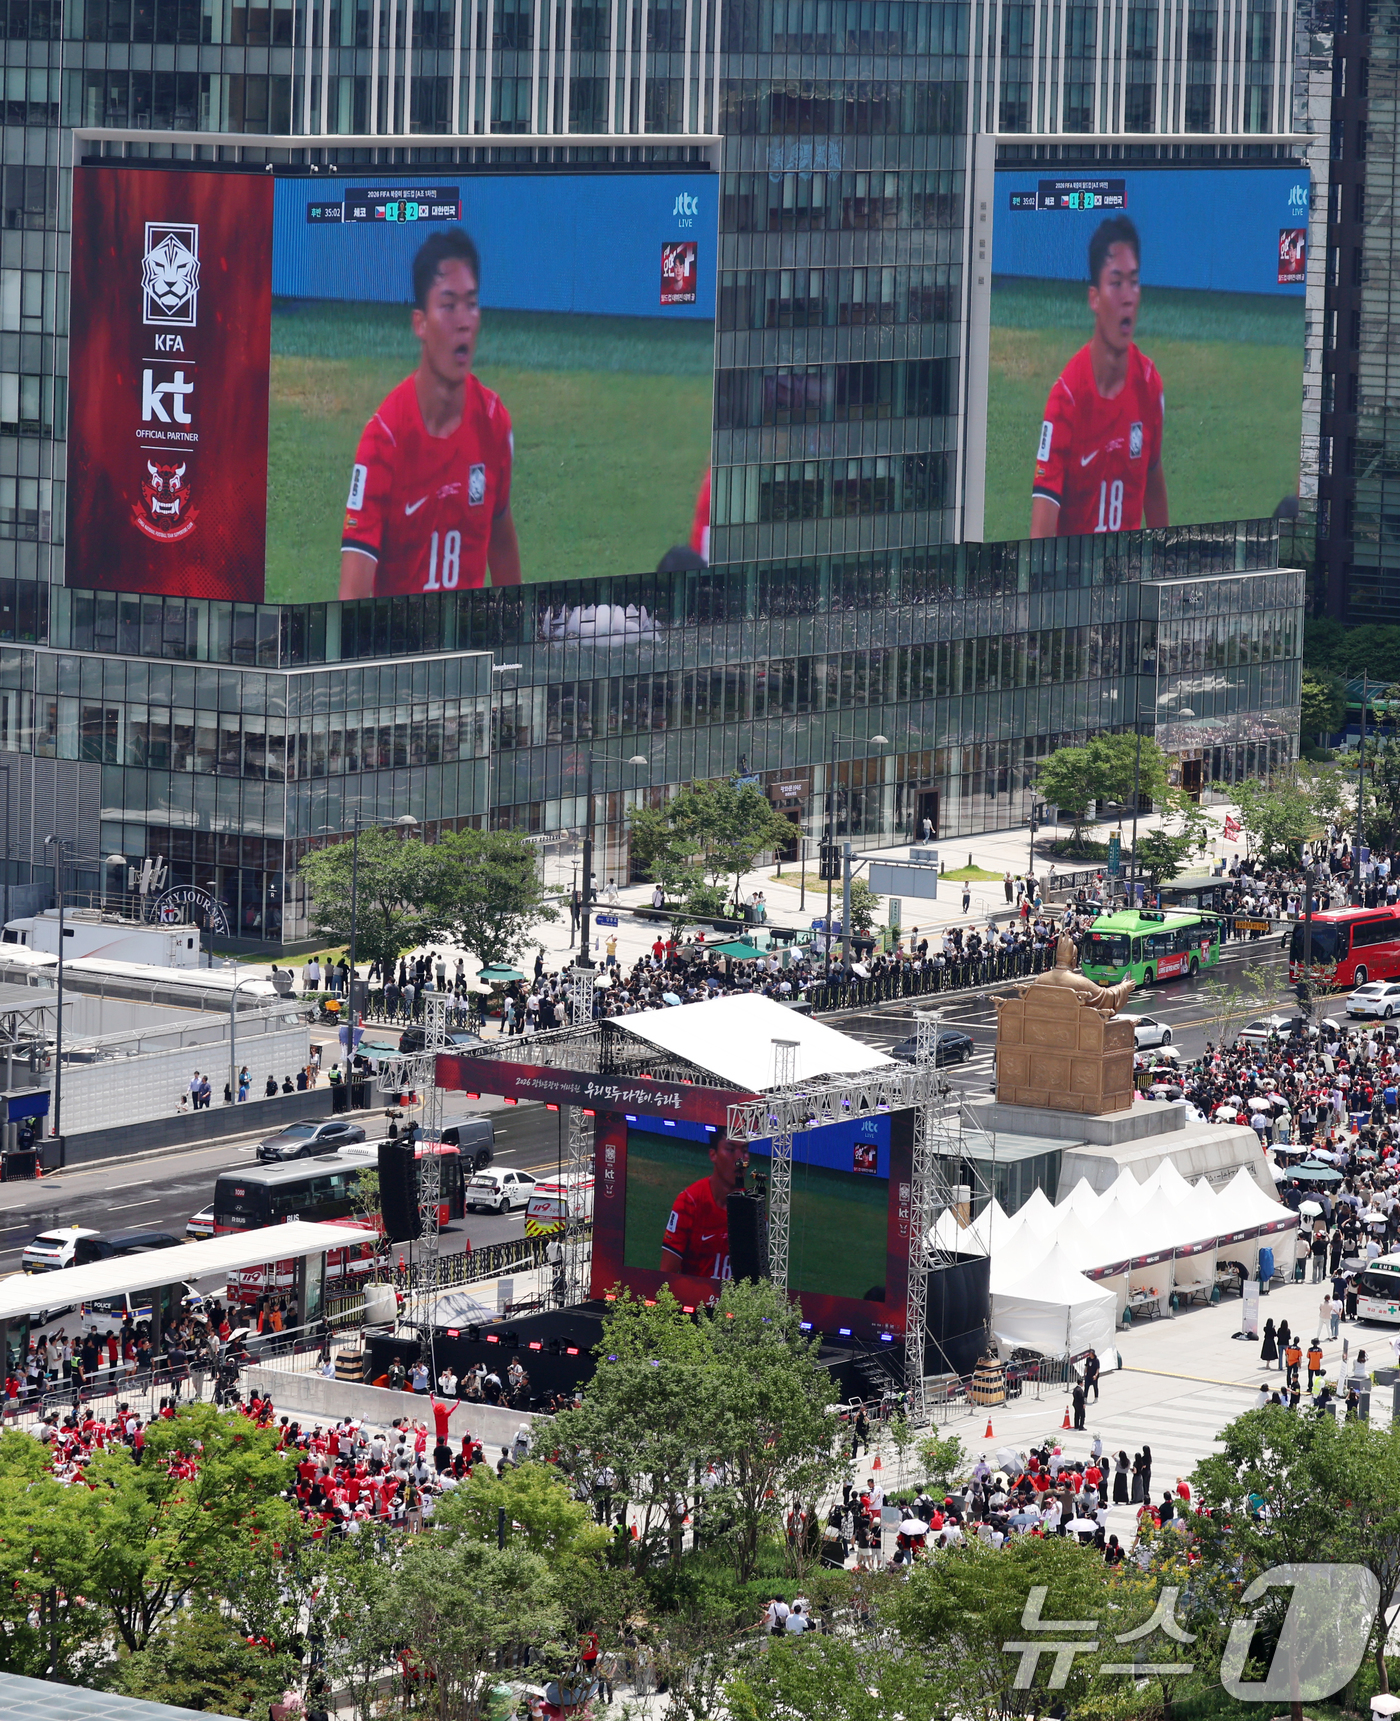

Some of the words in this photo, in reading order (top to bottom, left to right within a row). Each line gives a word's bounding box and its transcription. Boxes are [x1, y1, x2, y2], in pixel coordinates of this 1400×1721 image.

[380, 190, 390, 198] FIFA
[324, 208, 341, 217] 35:02
[353, 207, 367, 218] 체코
[389, 207, 394, 217] 1
[409, 206, 415, 217] 2
[431, 205, 456, 216] 대한민국
[678, 218, 693, 228] LIVE
[155, 333, 185, 352] KFA
[142, 368, 194, 424] kt
[135, 429, 166, 440] OFFICIAL
[167, 431, 199, 442] PARTNER
[1094, 479, 1124, 533] 18
[423, 530, 462, 592] 18
[515, 1077, 531, 1087] 2026
[604, 1168, 615, 1179] kt
[533, 1203, 551, 1212] 119
[898, 1207, 910, 1219] kt
[243, 1271, 262, 1282] 119
[94, 1301, 112, 1309] POLICE
